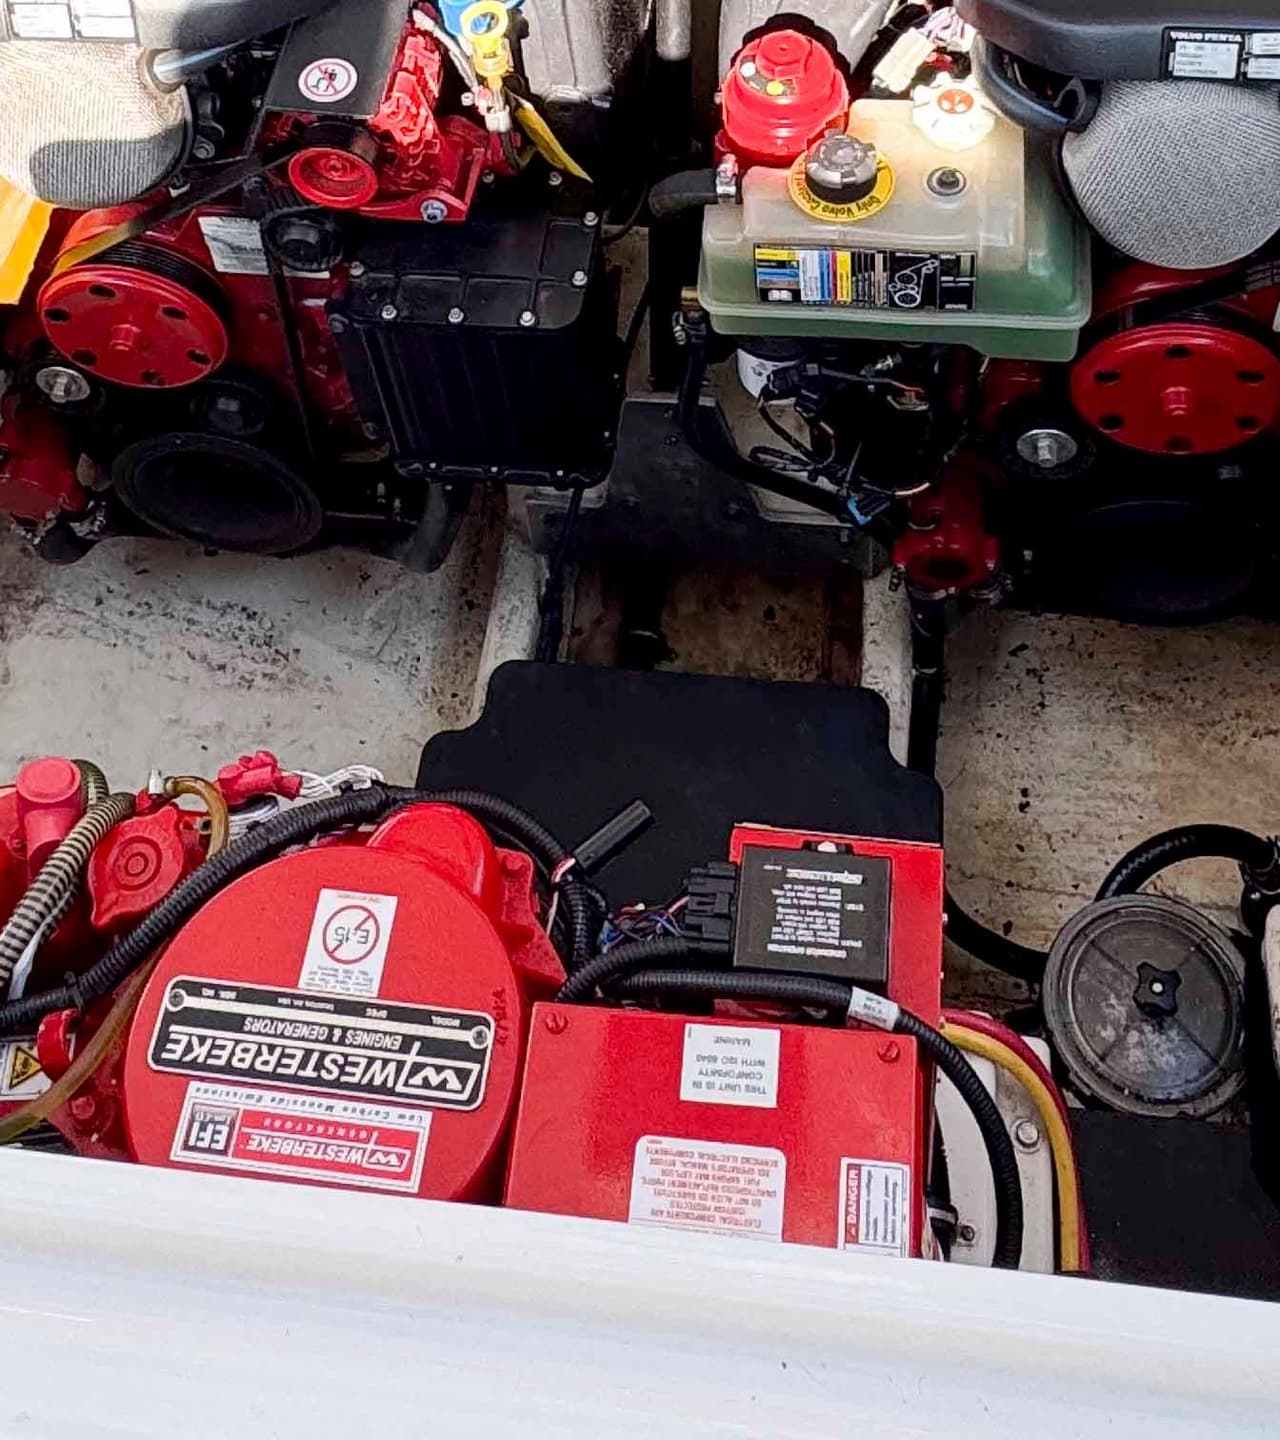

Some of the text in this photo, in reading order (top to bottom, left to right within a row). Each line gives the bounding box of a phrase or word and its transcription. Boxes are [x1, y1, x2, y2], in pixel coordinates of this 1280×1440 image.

[1170, 30, 1242, 42] VOLVO PENTA
[821, 204, 855, 218] Volvo
[242, 1017, 404, 1051] ENGINES & GENERATORS
[160, 1032, 399, 1089] WESTERBEKE
[697, 1067, 764, 1081] CONFORMITY
[692, 1079, 767, 1096] THIS UNIT IS IN
[188, 1120, 230, 1151] EFI
[246, 1134, 364, 1166] WESTERBEKE
[846, 1169, 860, 1225] DANGER
